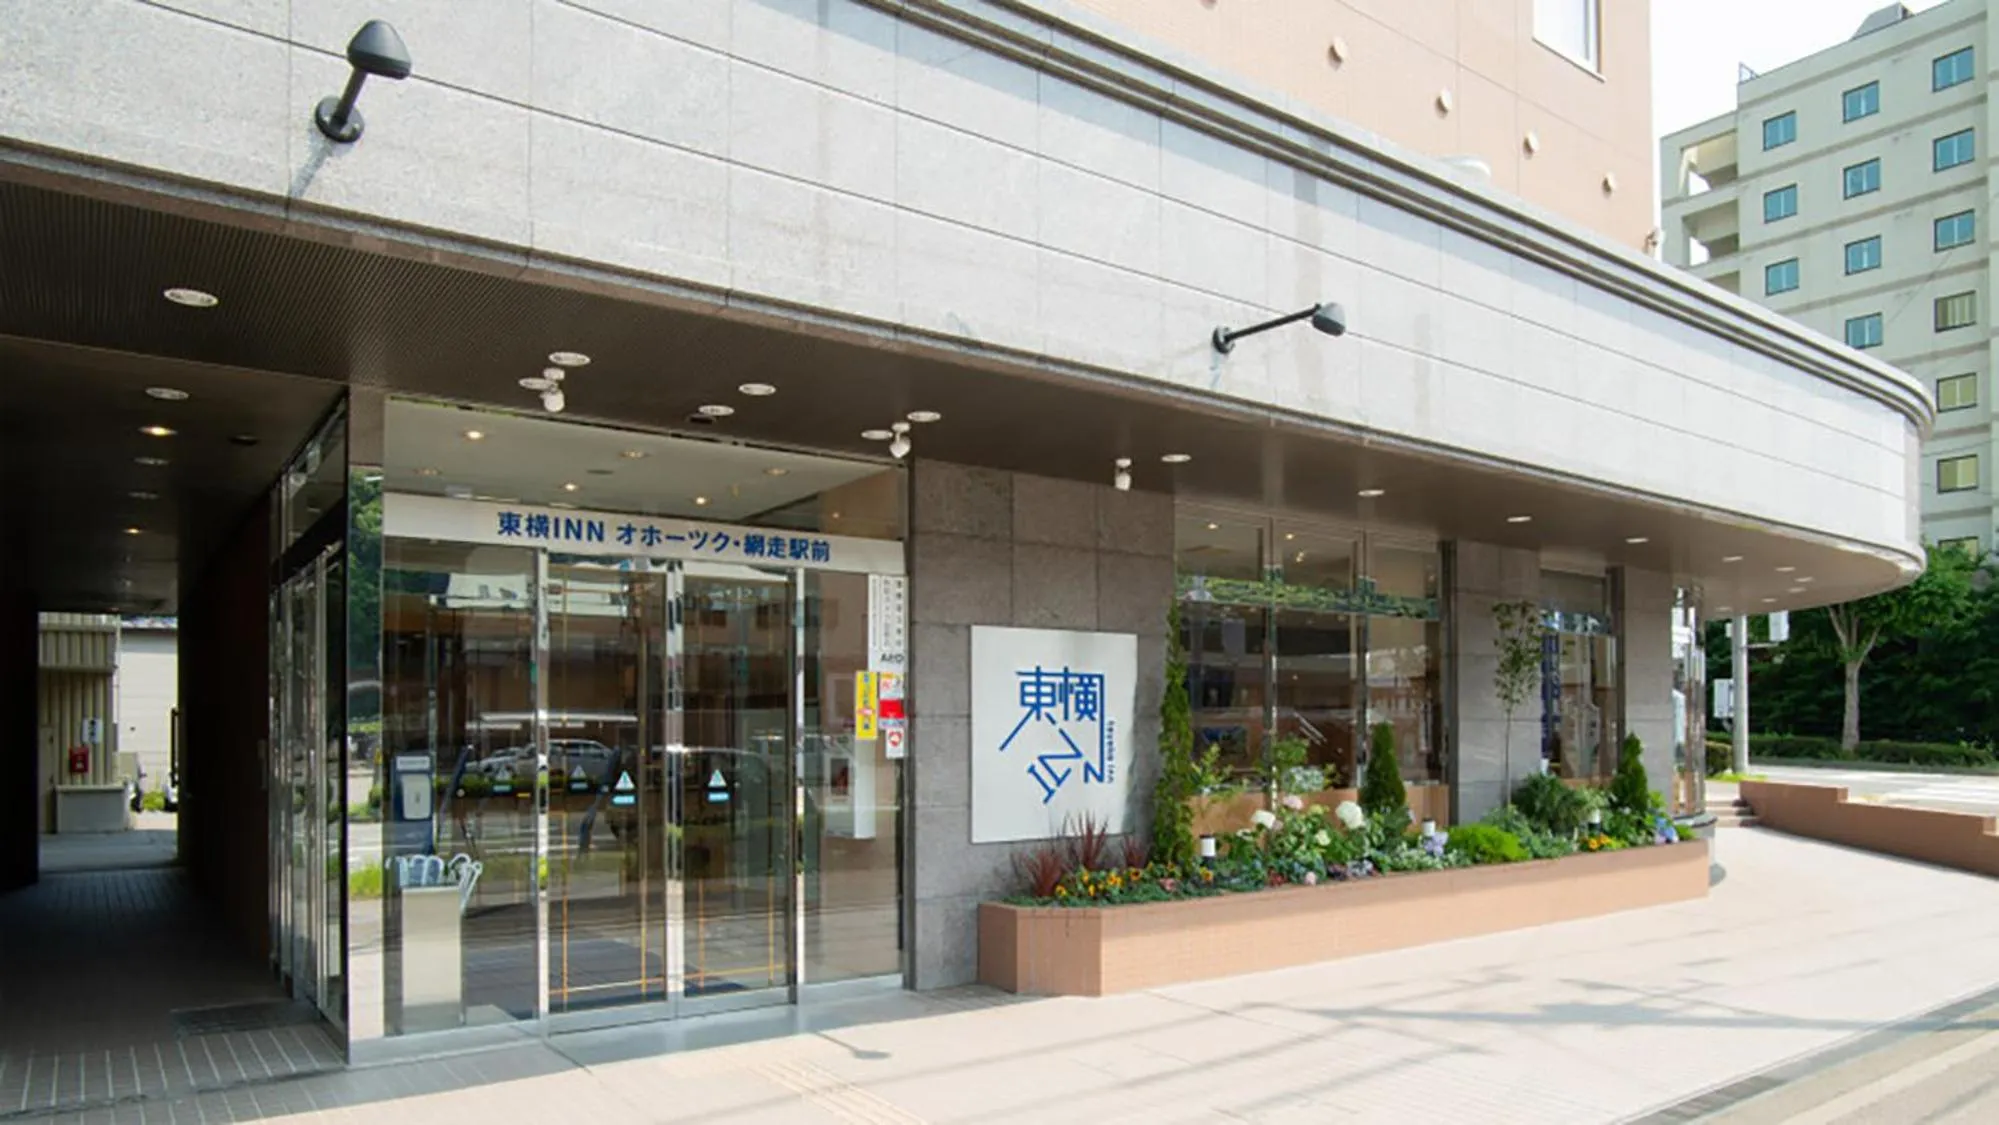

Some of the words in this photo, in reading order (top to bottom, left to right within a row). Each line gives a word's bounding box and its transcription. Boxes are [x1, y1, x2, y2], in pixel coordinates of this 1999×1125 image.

[498, 511, 604, 541] 東横INN
[616, 523, 831, 562] オホーツク・網走駅前
